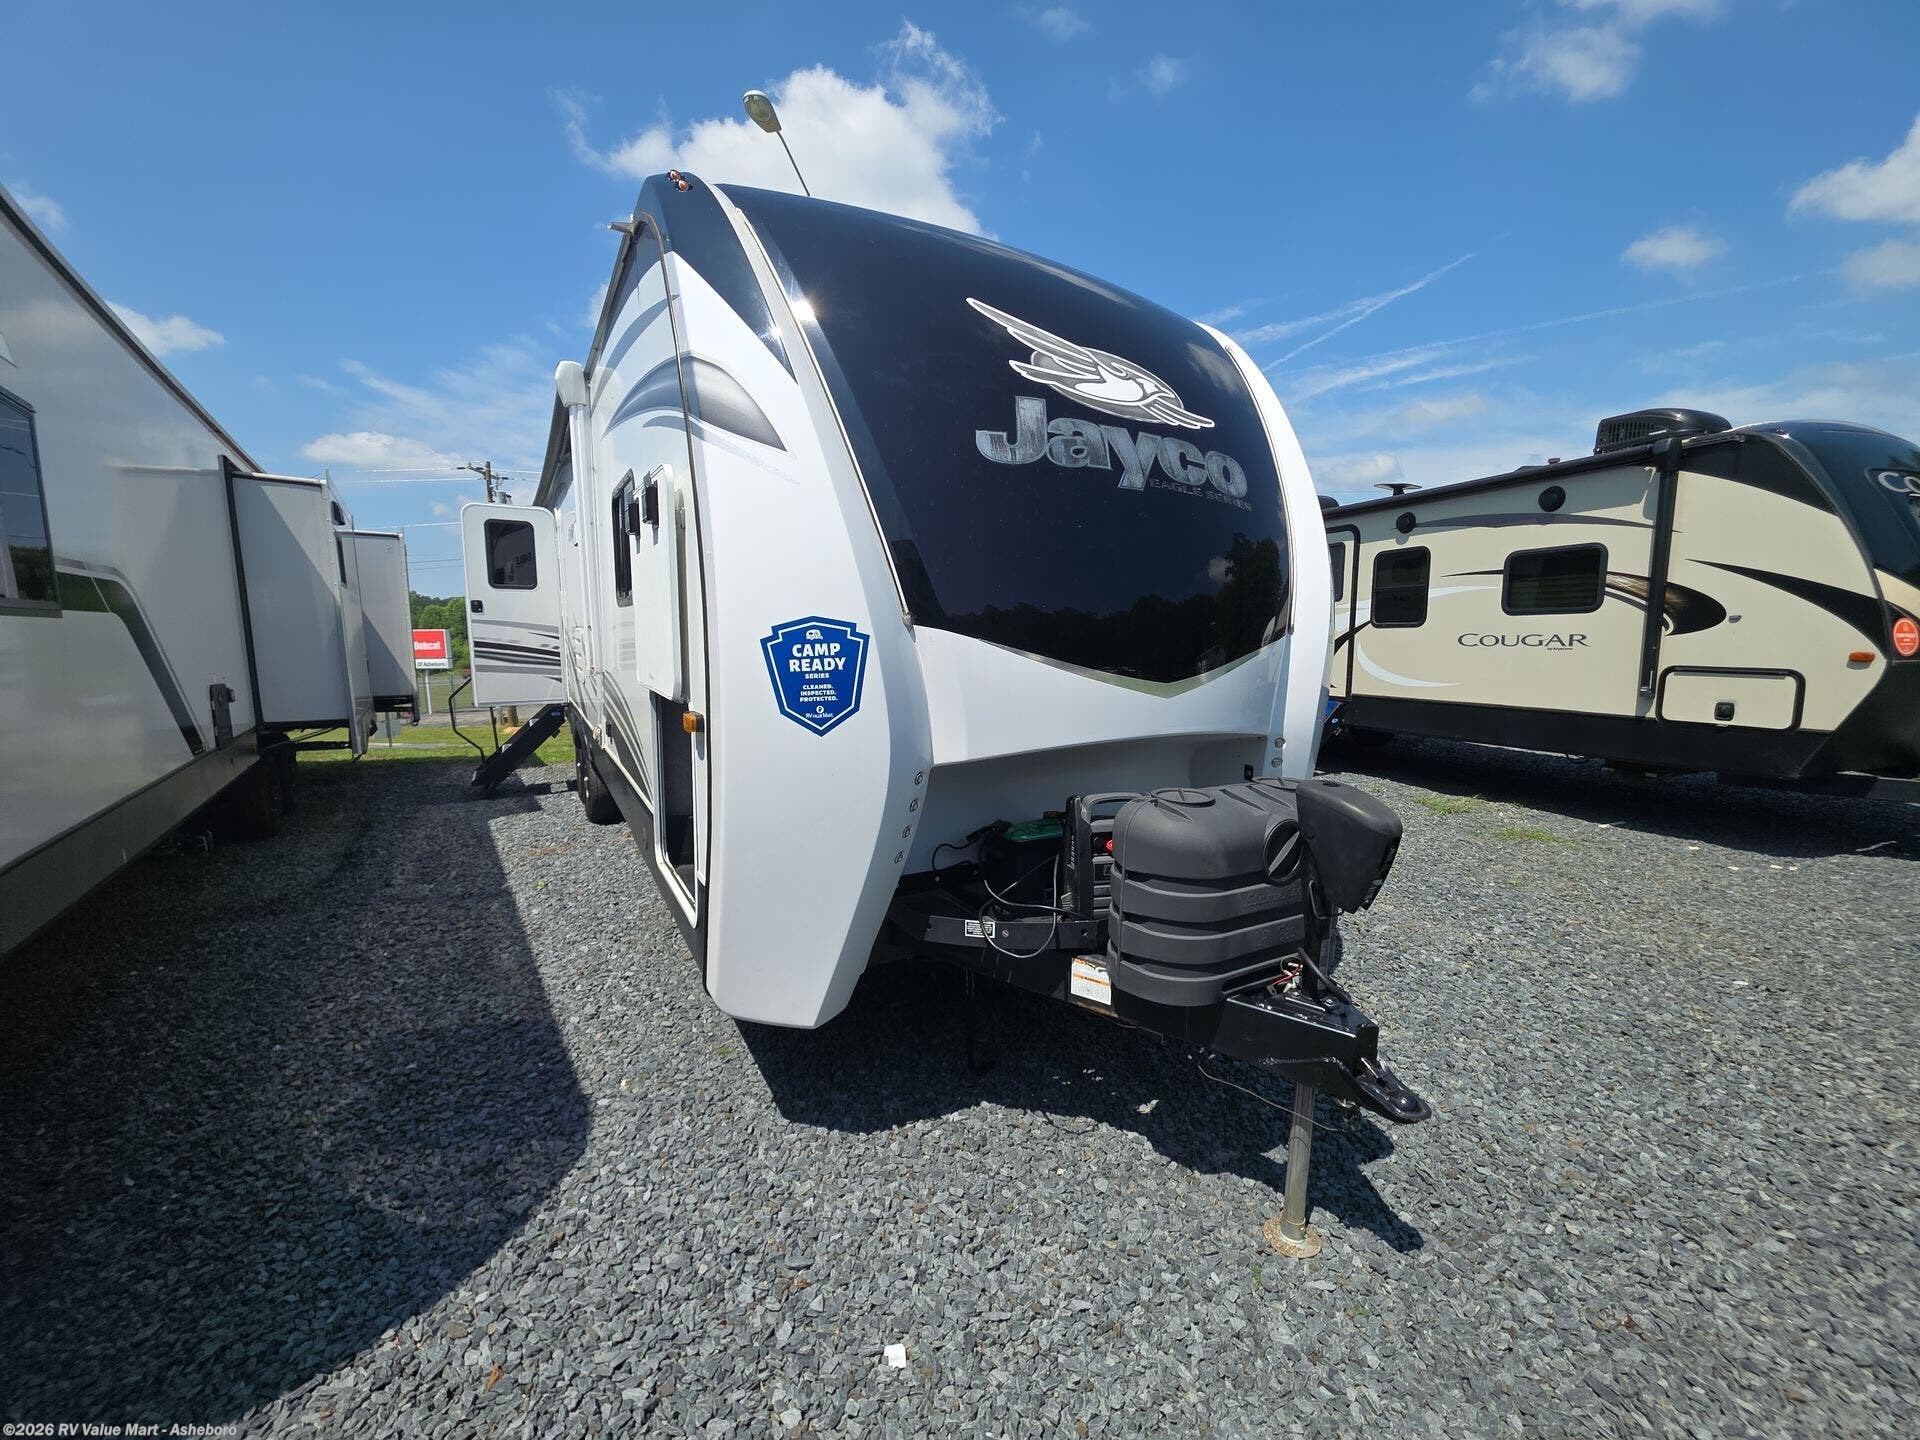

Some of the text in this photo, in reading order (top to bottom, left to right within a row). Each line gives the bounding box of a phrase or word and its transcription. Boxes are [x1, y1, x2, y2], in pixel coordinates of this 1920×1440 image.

[975, 395, 1248, 498] Jayco
[1149, 479, 1253, 512] EAGLE SERIES
[414, 641, 441, 650] Bobcat
[1457, 633, 1591, 647] COUGAR
[792, 643, 840, 657] CAMP
[788, 657, 846, 672] READY
